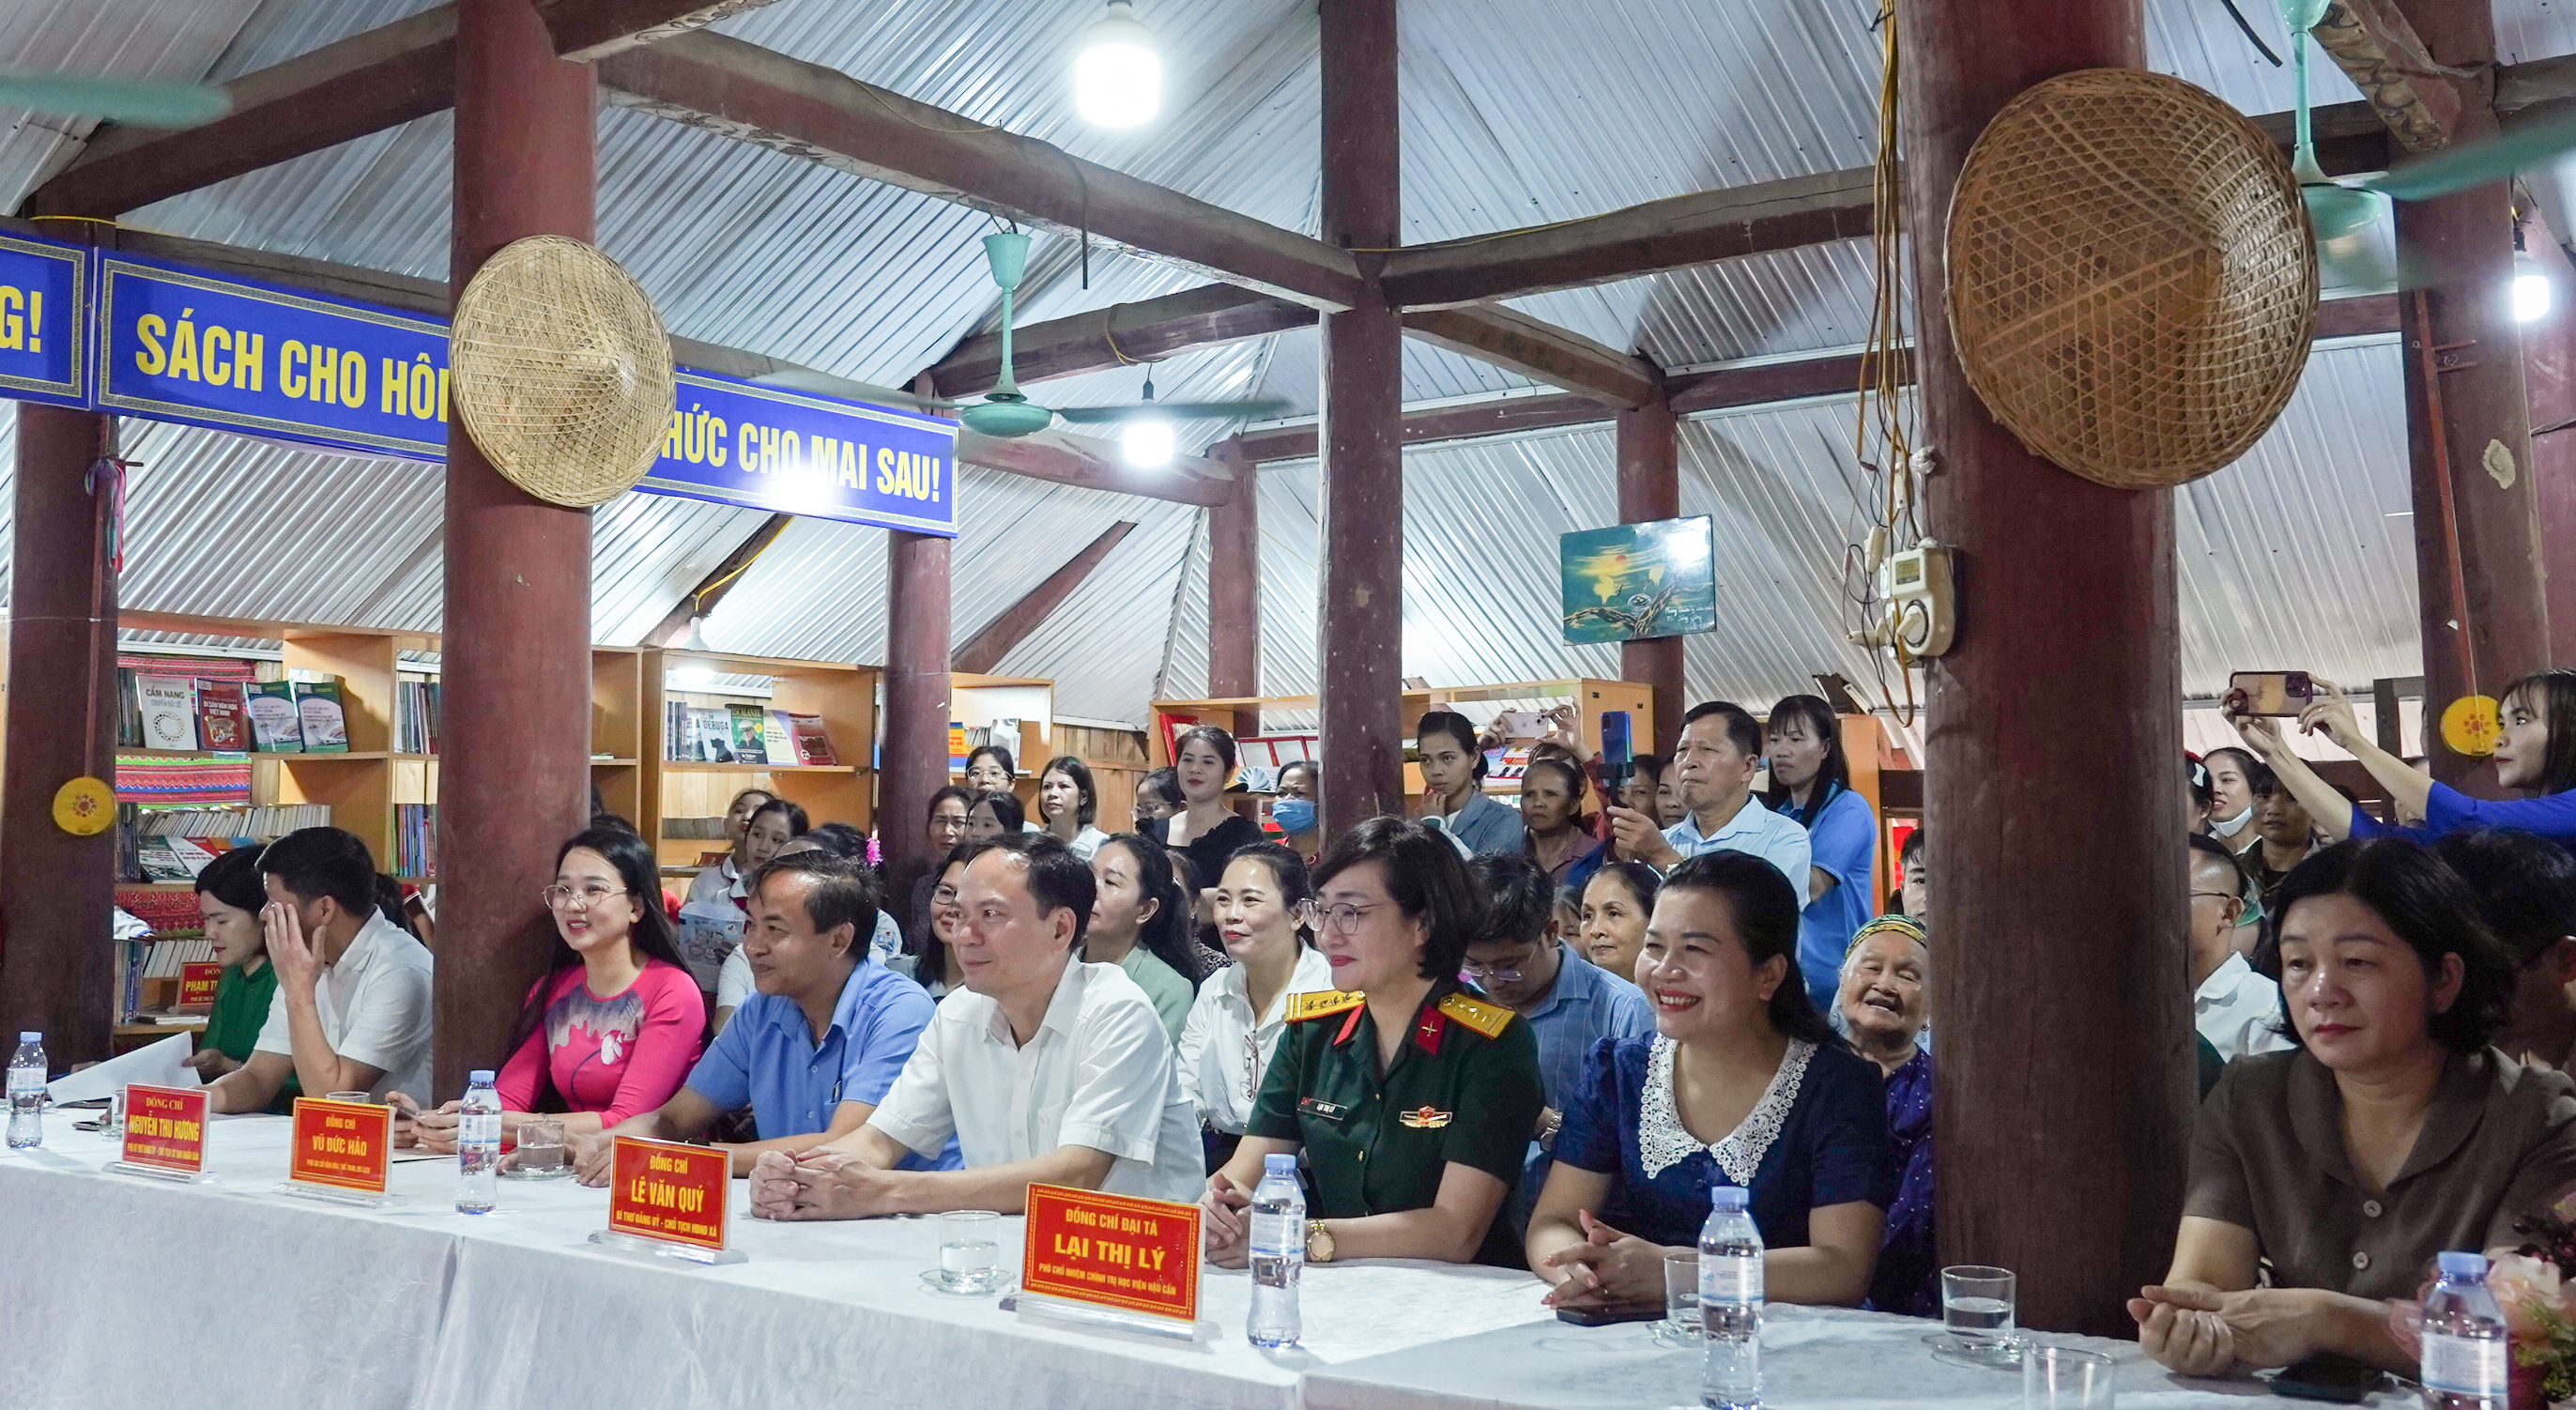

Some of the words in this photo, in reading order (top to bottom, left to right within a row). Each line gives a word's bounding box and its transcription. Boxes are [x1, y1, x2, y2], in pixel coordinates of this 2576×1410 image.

[135, 307, 264, 392] SÁCH
[279, 339, 367, 408] CHO
[661, 403, 728, 467] HỨC
[738, 421, 801, 476] CHO
[810, 435, 867, 490] MAI
[876, 447, 940, 503] SAU!
[163, 690, 185, 699] NANG
[702, 719, 729, 730] DERUGA
[185, 980, 208, 994] PHẠM
[169, 1097, 184, 1111] CHÍ
[129, 1110, 158, 1136] NGUYỄN
[159, 1118, 174, 1139] THU
[313, 1133, 325, 1151] VŨ
[327, 1135, 345, 1154] ĐỨC
[650, 1152, 673, 1172] ĐỒNG
[674, 1157, 689, 1174] CHÍ
[631, 1175, 647, 1203] LÊ
[649, 1179, 675, 1208] VĂN
[678, 1185, 705, 1213] QUÝ
[1066, 1205, 1096, 1226] ĐỒNG
[1099, 1213, 1119, 1230] CHÍ
[1121, 1218, 1141, 1236] ĐẠI
[1143, 1218, 1158, 1236] TÁ
[1054, 1233, 1089, 1261] LẠI
[1096, 1239, 1132, 1270] THỊ
[1138, 1246, 1166, 1271] LÝ
[1051, 1264, 1066, 1276] CHỦ
[1107, 1274, 1117, 1286] TRỊ
[1117, 1277, 1131, 1289] HỌC
[1131, 1278, 1147, 1292] VIỆN
